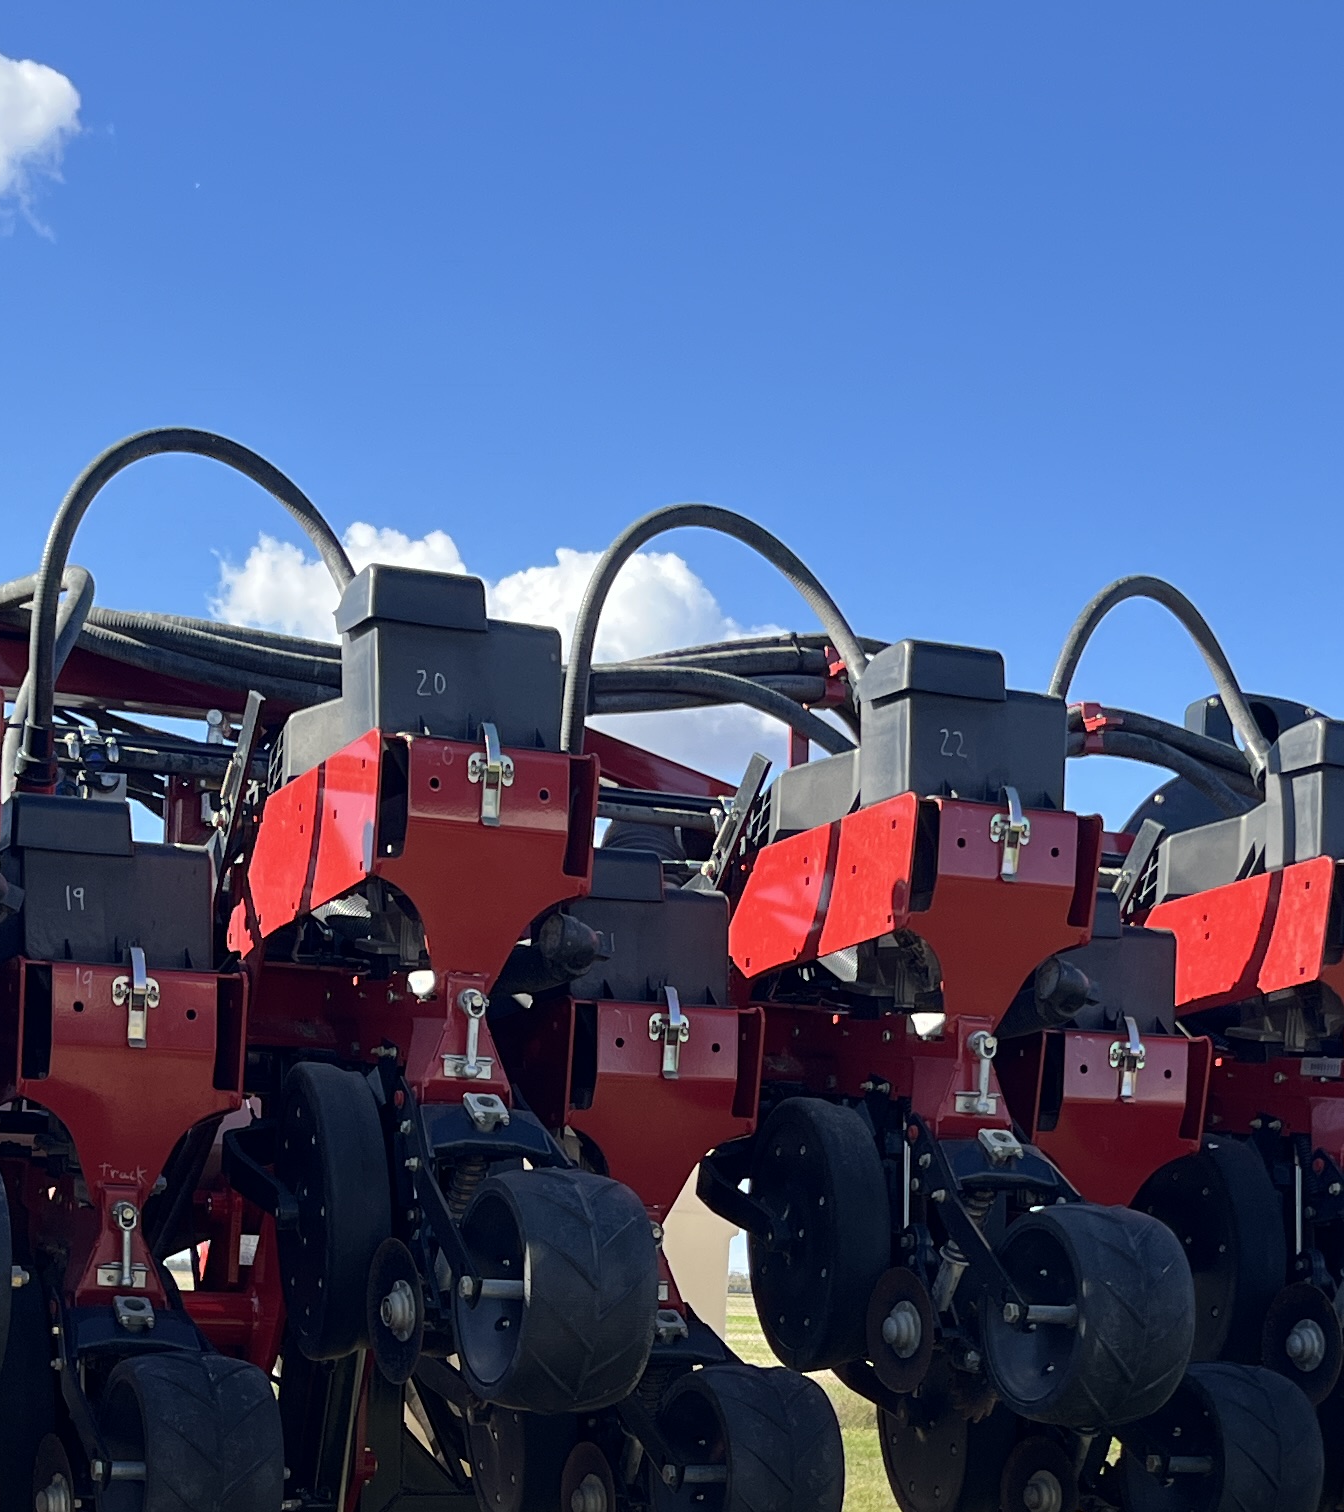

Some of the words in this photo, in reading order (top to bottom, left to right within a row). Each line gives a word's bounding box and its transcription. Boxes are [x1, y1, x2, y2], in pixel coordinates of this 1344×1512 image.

[416, 669, 448, 698] 20
[939, 728, 968, 759] 22
[65, 885, 86, 912] 19
[75, 966, 94, 999] 19
